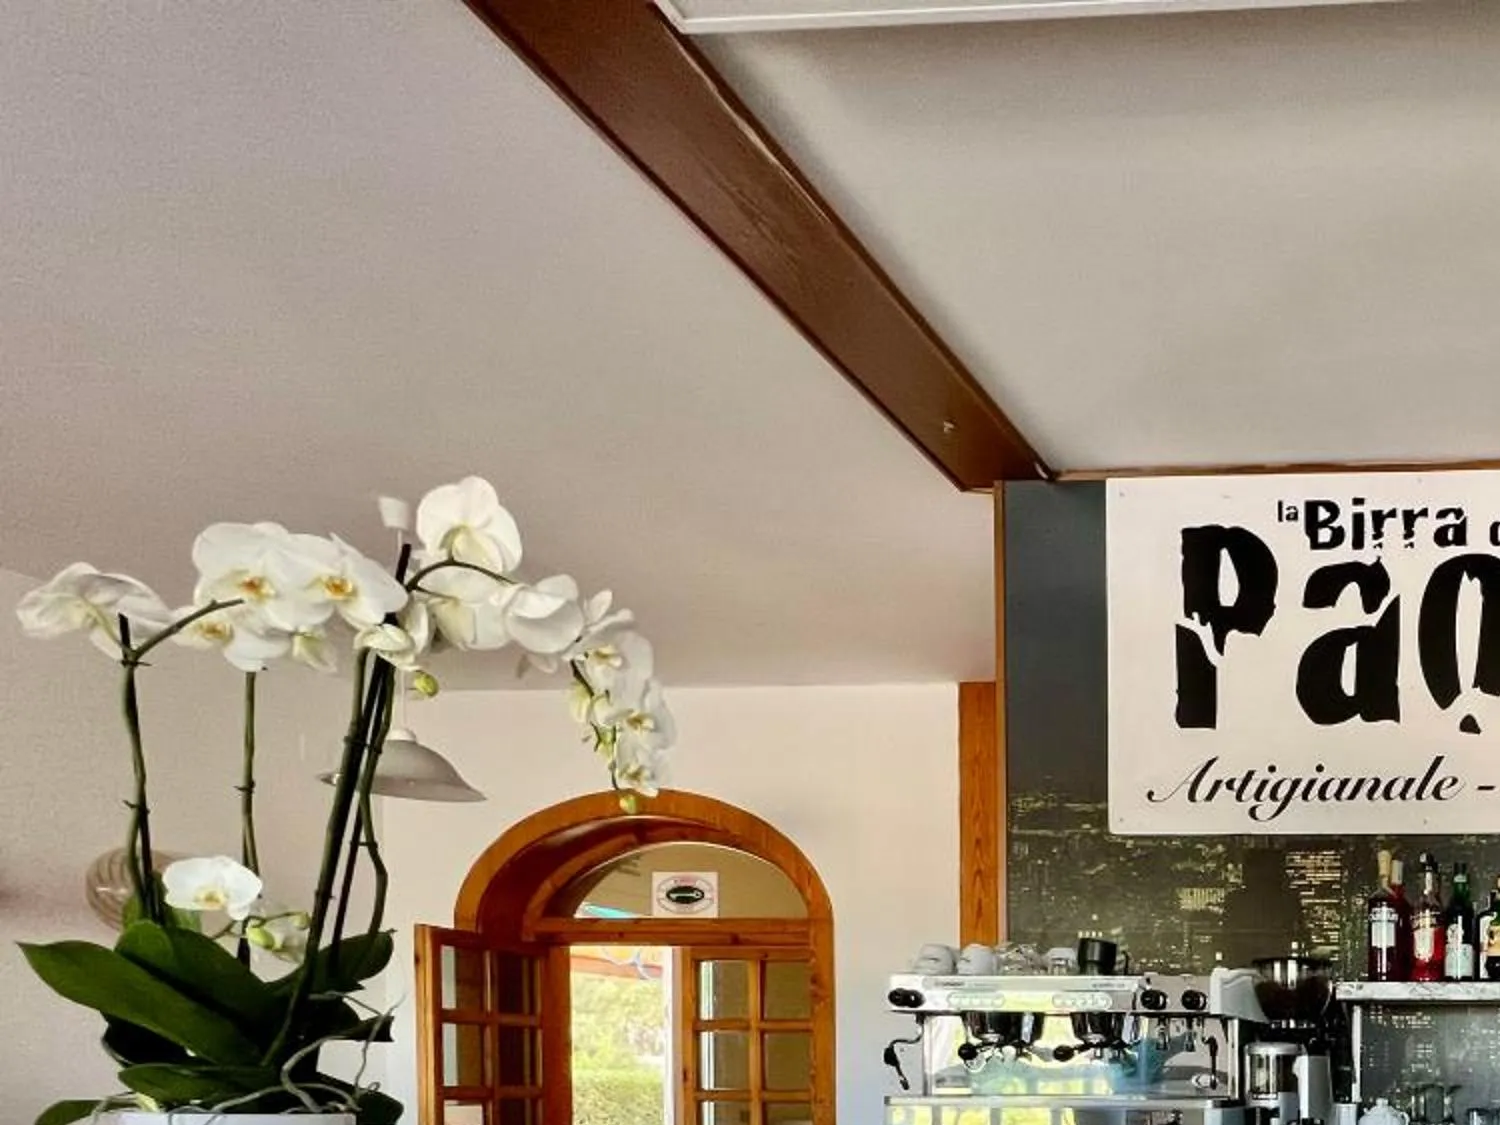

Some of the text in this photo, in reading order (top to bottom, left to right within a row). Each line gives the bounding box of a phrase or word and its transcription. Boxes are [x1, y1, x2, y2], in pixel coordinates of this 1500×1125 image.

[1277, 500, 1299, 523] la
[1304, 498, 1467, 551] Birra
[1146, 755, 1466, 822] Artigianale
